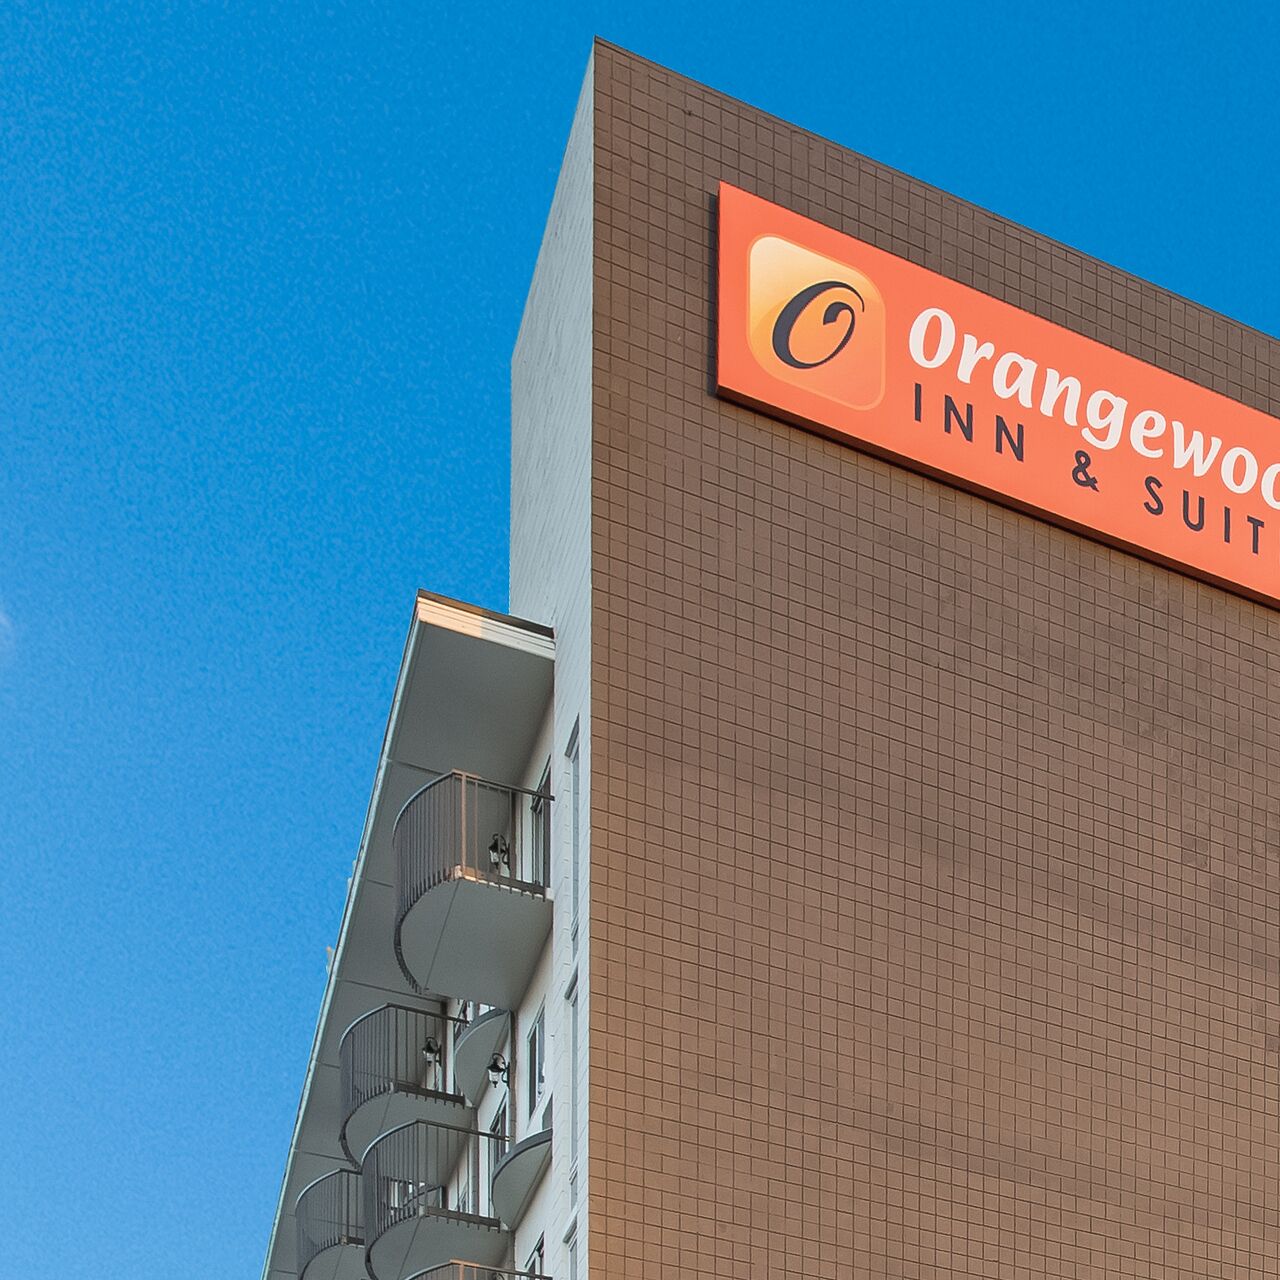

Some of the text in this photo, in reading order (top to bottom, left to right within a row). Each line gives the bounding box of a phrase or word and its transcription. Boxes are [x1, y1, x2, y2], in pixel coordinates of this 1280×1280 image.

[772, 280, 865, 369] O
[914, 383, 1025, 463] INN
[1072, 450, 1100, 491] &
